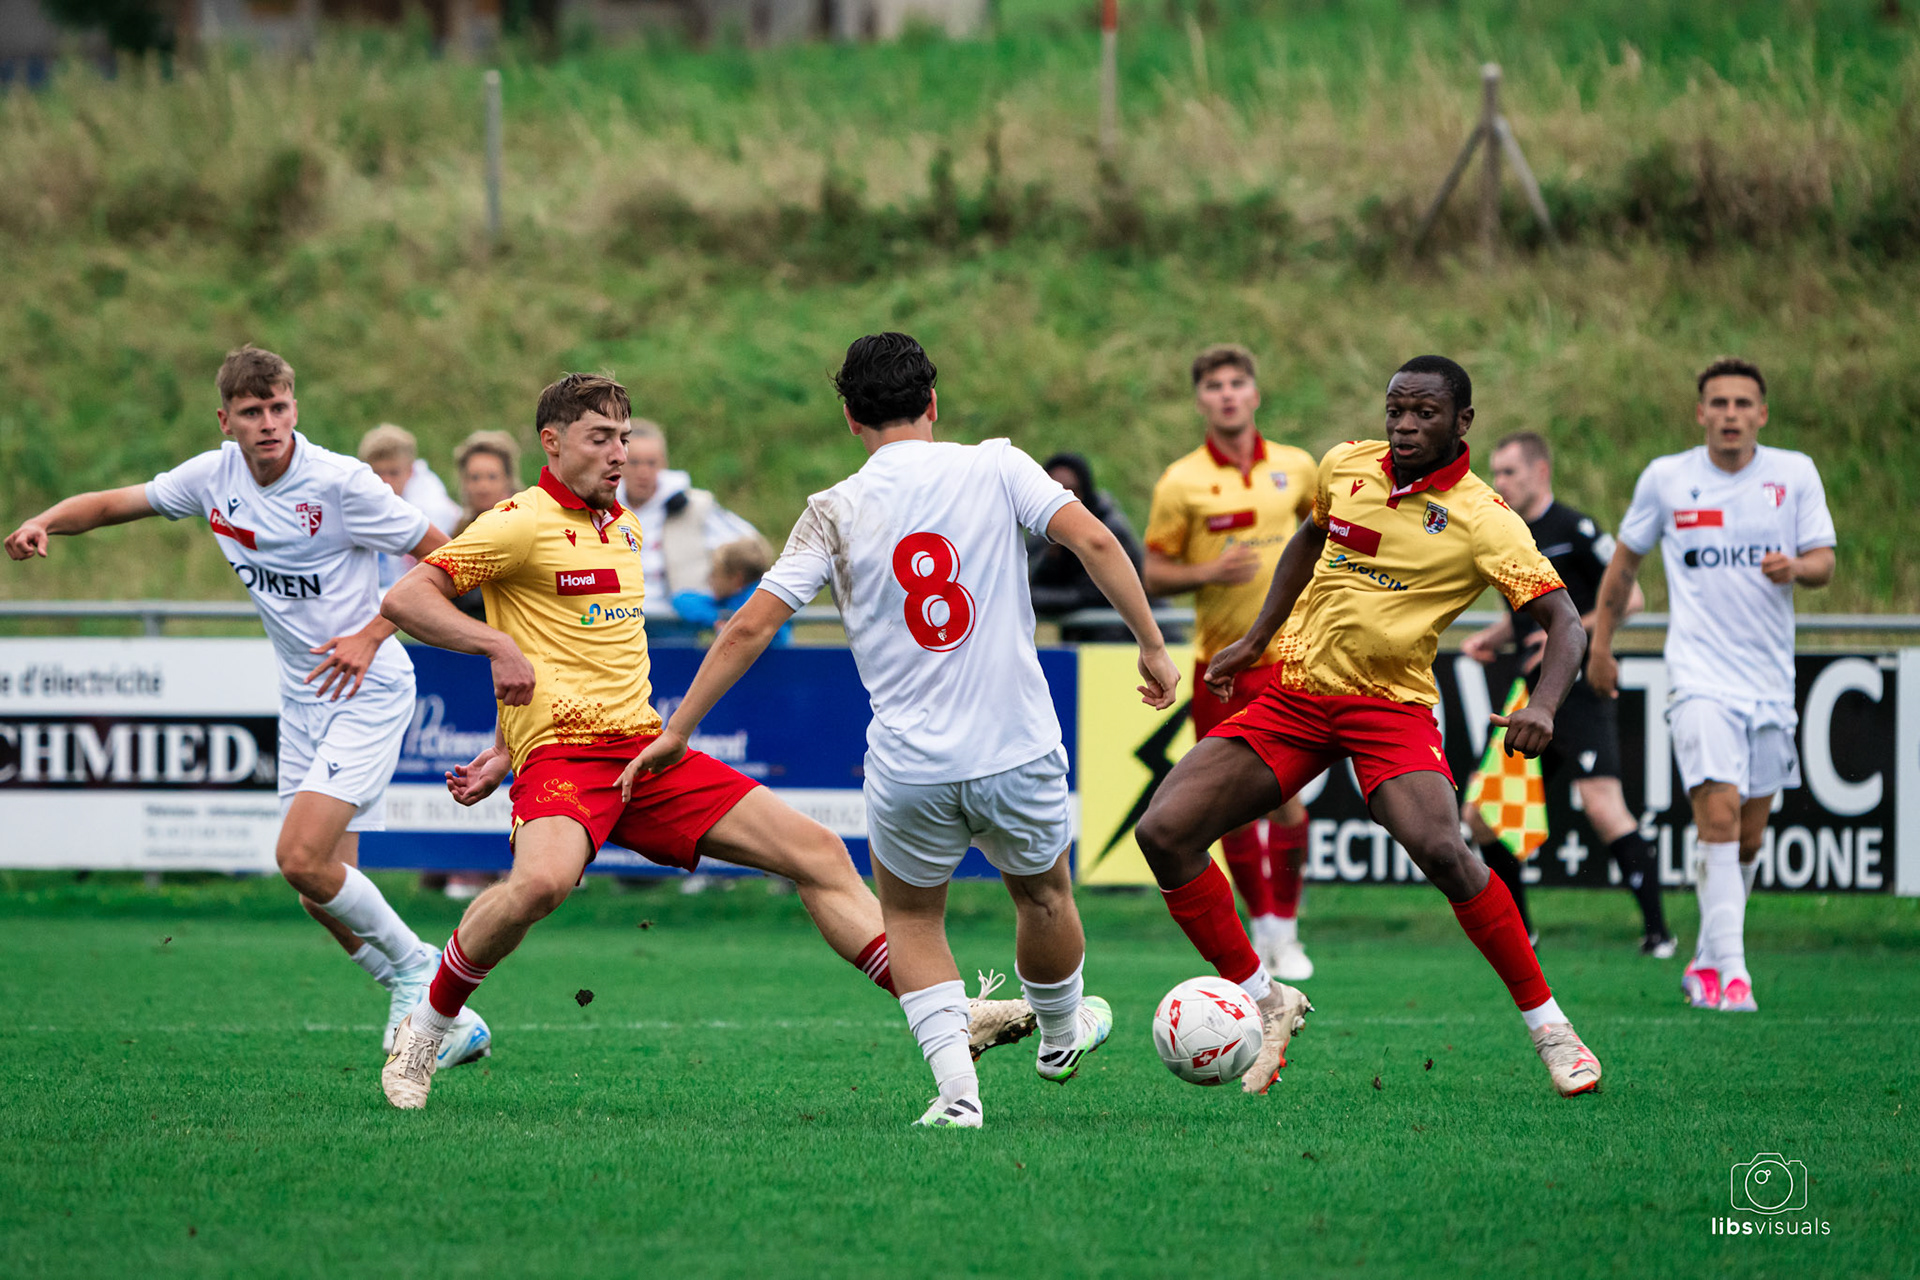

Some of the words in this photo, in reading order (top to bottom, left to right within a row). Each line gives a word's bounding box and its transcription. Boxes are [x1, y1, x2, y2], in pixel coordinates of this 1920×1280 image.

[1701, 545, 1782, 568] OIKE
[235, 564, 321, 598] OIKEN
[560, 573, 596, 587] Hoval
[1347, 560, 1408, 591] HOLCIM
[892, 531, 976, 652] 8
